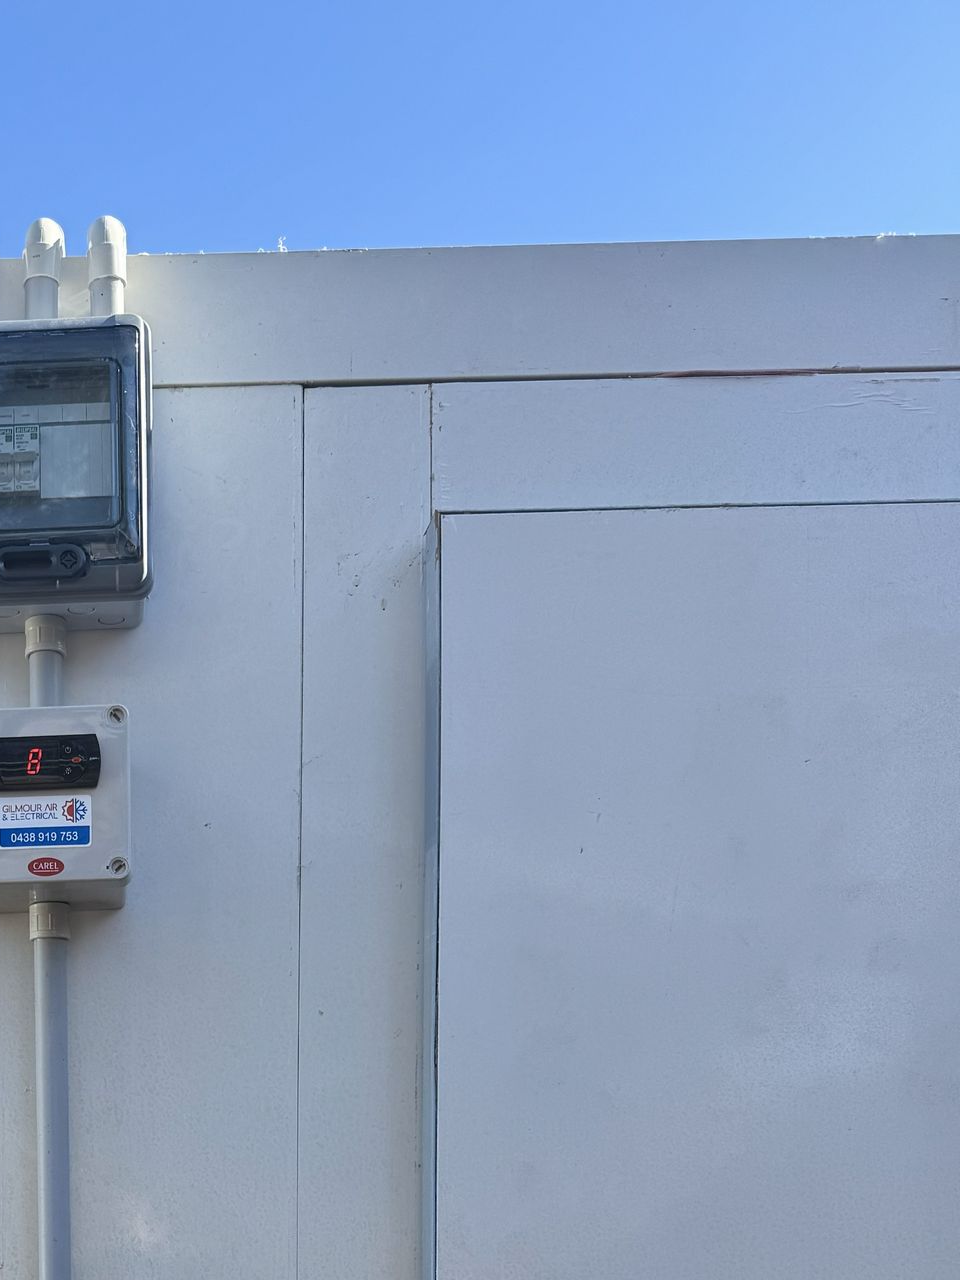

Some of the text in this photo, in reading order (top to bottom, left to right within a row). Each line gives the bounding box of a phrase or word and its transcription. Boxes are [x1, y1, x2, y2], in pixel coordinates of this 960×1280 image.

[26, 748, 42, 775] 8
[2, 802, 58, 813] GILMOUR AIR
[2, 812, 58, 821] & ELECTRICAL
[10, 831, 78, 843] 0438 919 753
[32, 862, 59, 870] CAREL
